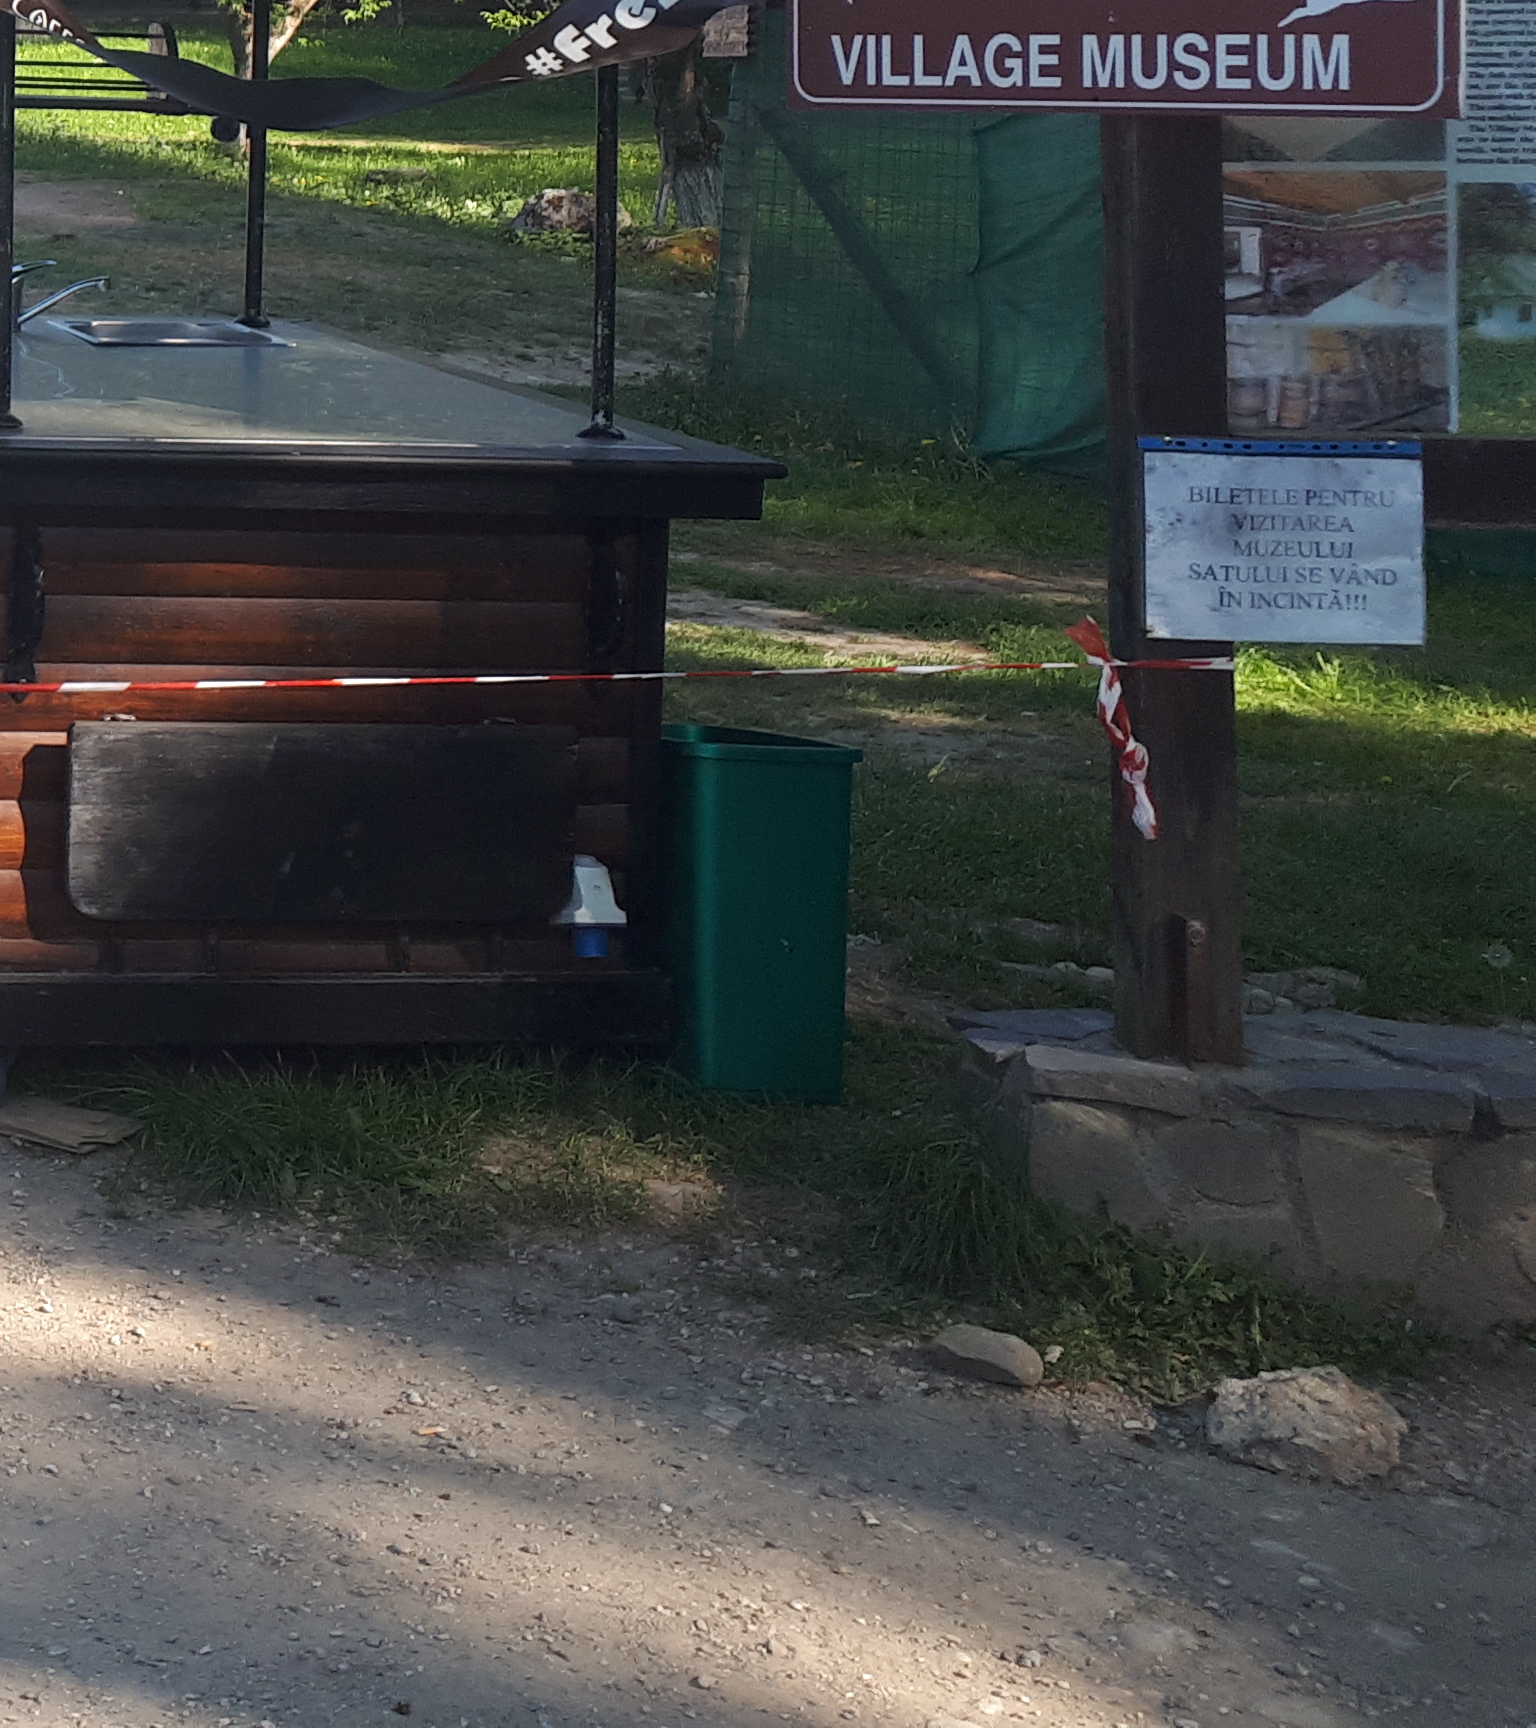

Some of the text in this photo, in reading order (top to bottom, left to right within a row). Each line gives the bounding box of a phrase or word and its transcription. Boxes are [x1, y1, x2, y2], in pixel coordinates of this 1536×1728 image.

[831, 32, 1351, 91] VILLAGE MUSEUM
[1189, 486, 1394, 507] BILETELE PENTRU
[1231, 513, 1355, 533] VIZITAREA
[1233, 539, 1354, 559] MUZEULUI
[1188, 562, 1398, 586] SATULUI SE VÂND
[1217, 586, 1367, 610] ÎN INCINTĂ!!!
